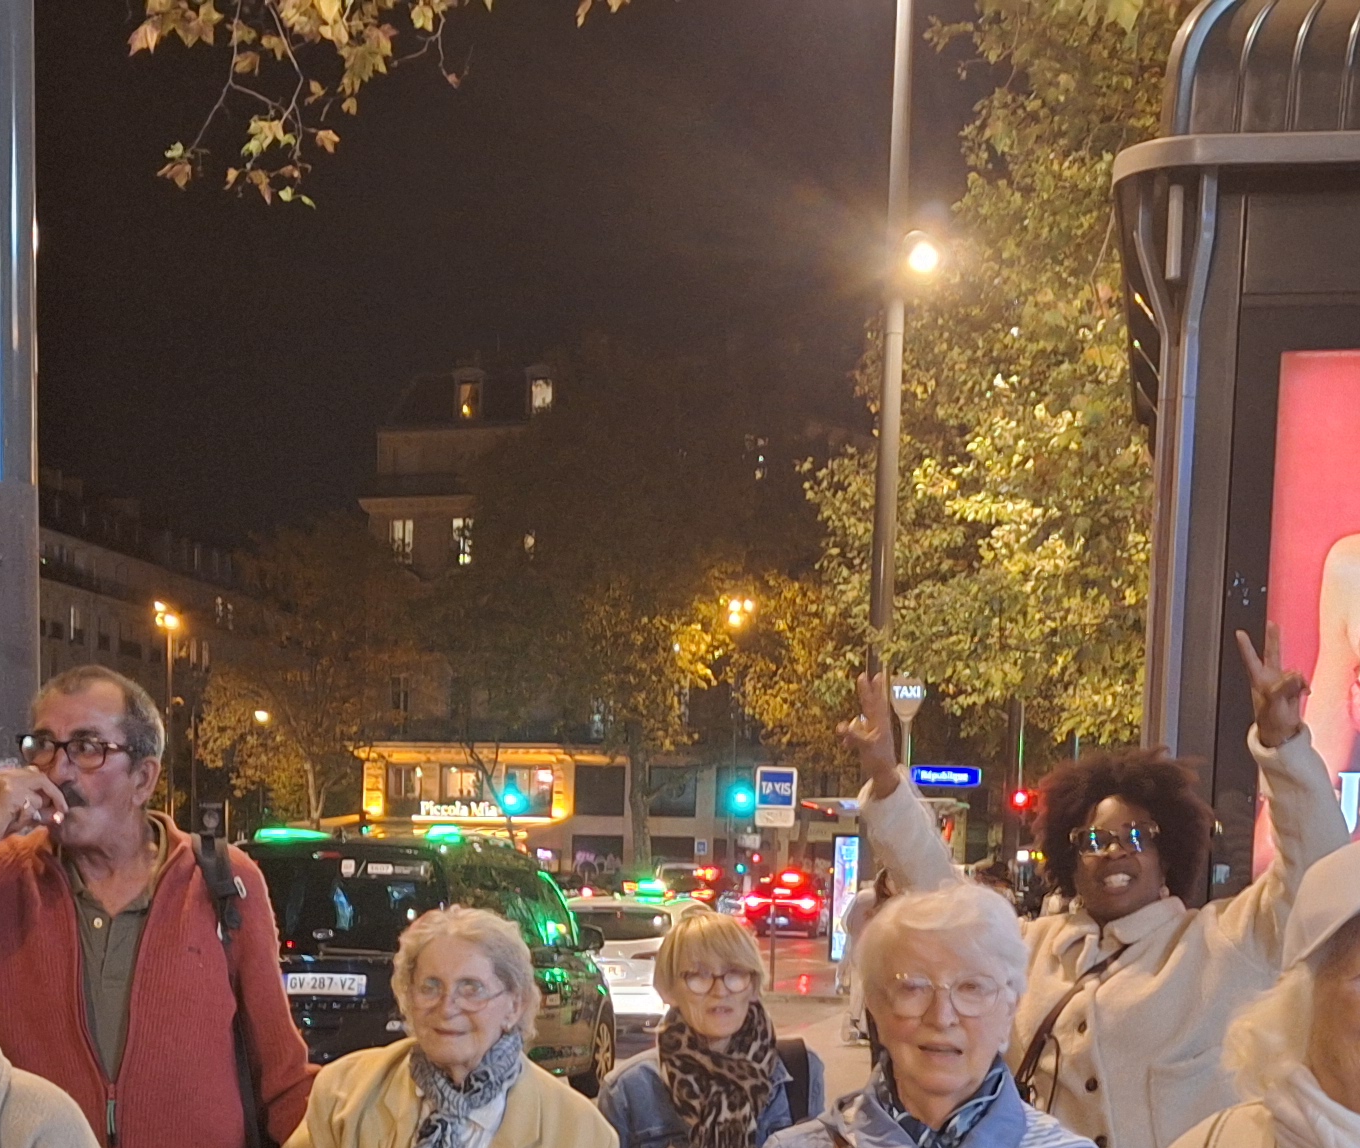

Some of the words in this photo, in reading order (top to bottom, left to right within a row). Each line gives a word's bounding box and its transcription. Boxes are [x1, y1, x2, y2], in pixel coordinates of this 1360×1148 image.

[892, 685, 921, 700] TAXI
[920, 769, 969, 784] République
[761, 781, 792, 797] TAXIS
[420, 800, 469, 817] Piccola
[470, 801, 498, 817] Mia
[290, 976, 356, 991] GV-287-VZ
